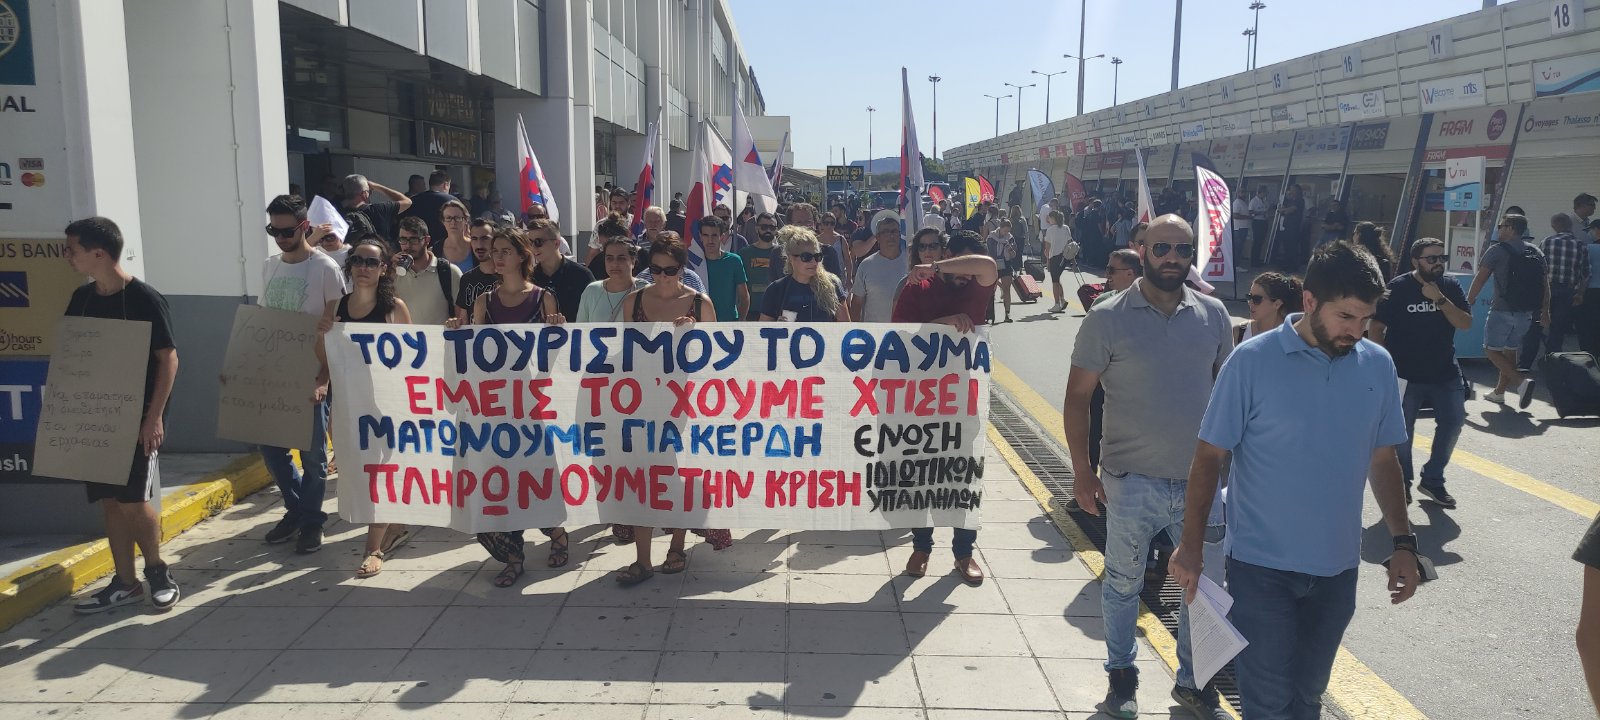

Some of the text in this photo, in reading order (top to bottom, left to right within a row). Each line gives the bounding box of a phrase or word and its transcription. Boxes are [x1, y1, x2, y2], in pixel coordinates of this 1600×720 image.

[1554, 4, 1570, 29] 18
[1430, 34, 1441, 55] 17
[1343, 56, 1353, 73] 16
[1273, 73, 1281, 89] 15
[0, 95, 36, 113] AL
[1421, 88, 1455, 105] Welcome
[1439, 119, 1474, 137] FRAM
[21, 159, 43, 169] VISA
[1427, 151, 1447, 160] FRAM
[828, 167, 849, 176] TAXI
[1407, 301, 1440, 313] adid
[11, 333, 42, 344] hours
[12, 343, 36, 351] CASH
[350, 327, 991, 374] ΤΟΥ ΤΟΥΡΙΣΜΟΥ ΤΟ ΘΑΥΜΑ
[405, 376, 558, 421] ΕΜΕΙΣ
[580, 377, 643, 417] ΤΟ
[849, 373, 980, 418] ΧΤΙΣΕΙ
[358, 414, 823, 459] ΜΑΤΩΝΟΥΜΕ ΓΙΑ ΚΕΡΔΗ
[853, 421, 962, 457] ΕΝΩΣΗ
[865, 455, 985, 488] ΙΔΙΩΤΙΚΩΝ
[764, 470, 862, 509] ΚΡΙΣΗ
[865, 488, 984, 513] ΥΠΑΛΛΗΛΩΝ
